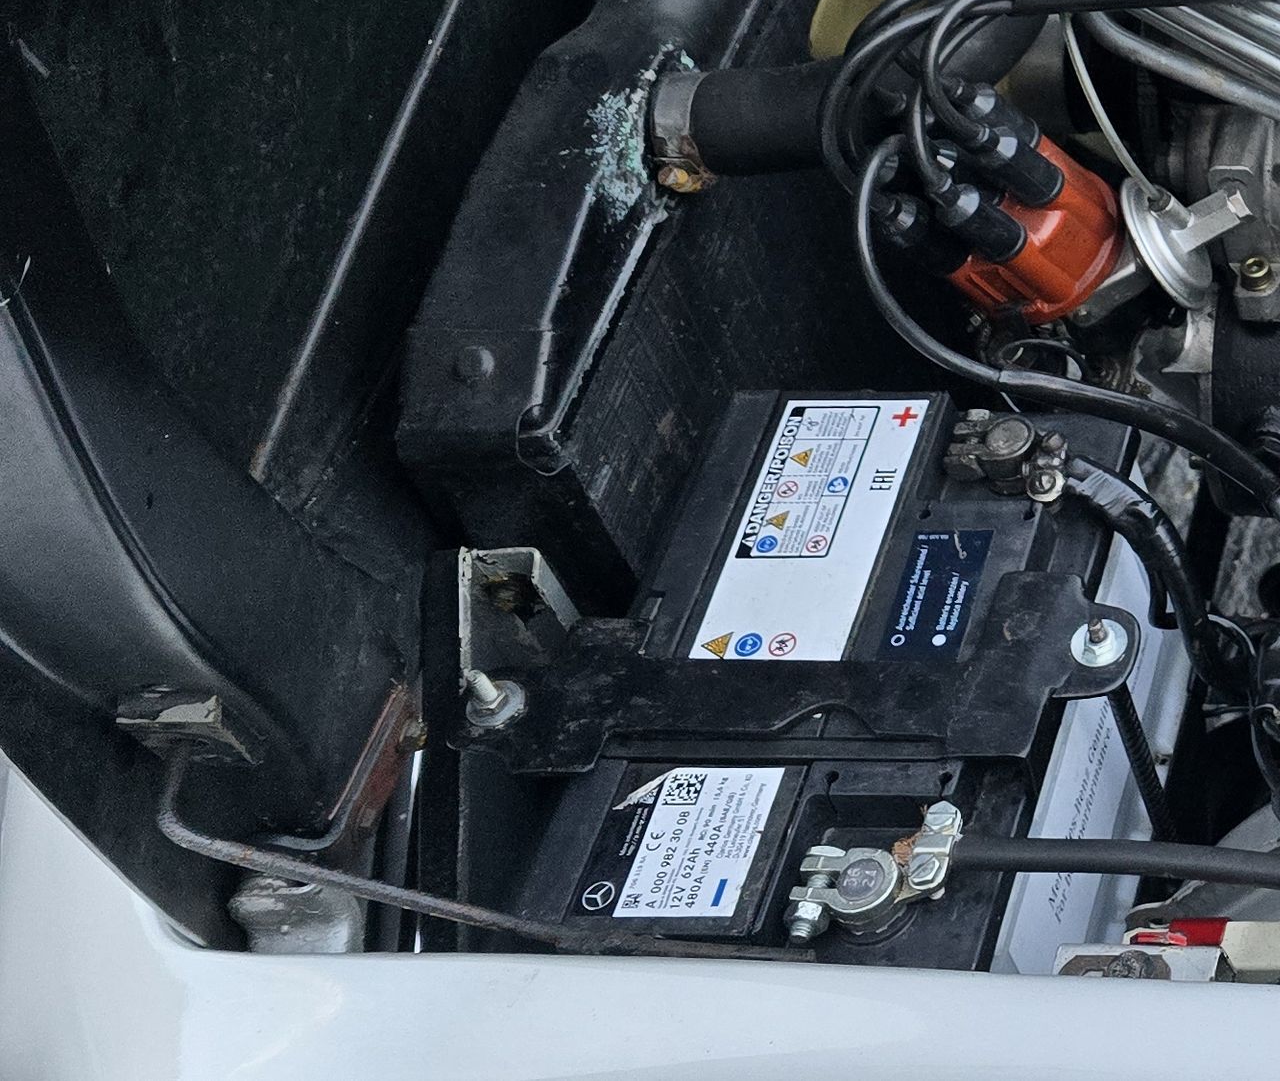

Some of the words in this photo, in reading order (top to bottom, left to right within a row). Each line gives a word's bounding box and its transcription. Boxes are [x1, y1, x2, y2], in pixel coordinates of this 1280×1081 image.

[749, 416, 803, 533] DANGER/POISON
[1047, 767, 1090, 910] Meres-Benz
[1086, 699, 1109, 764] Genuin
[676, 811, 690, 825] 08
[646, 830, 666, 851] CE
[669, 828, 683, 843] 30
[660, 846, 677, 868] 982
[669, 886, 686, 908] 12V
[681, 848, 701, 879] 62Ah
[702, 818, 712, 828] 90
[685, 875, 705, 908] 480A
[704, 824, 724, 856] 440A
[650, 871, 667, 894] 000
[645, 900, 657, 909] A
